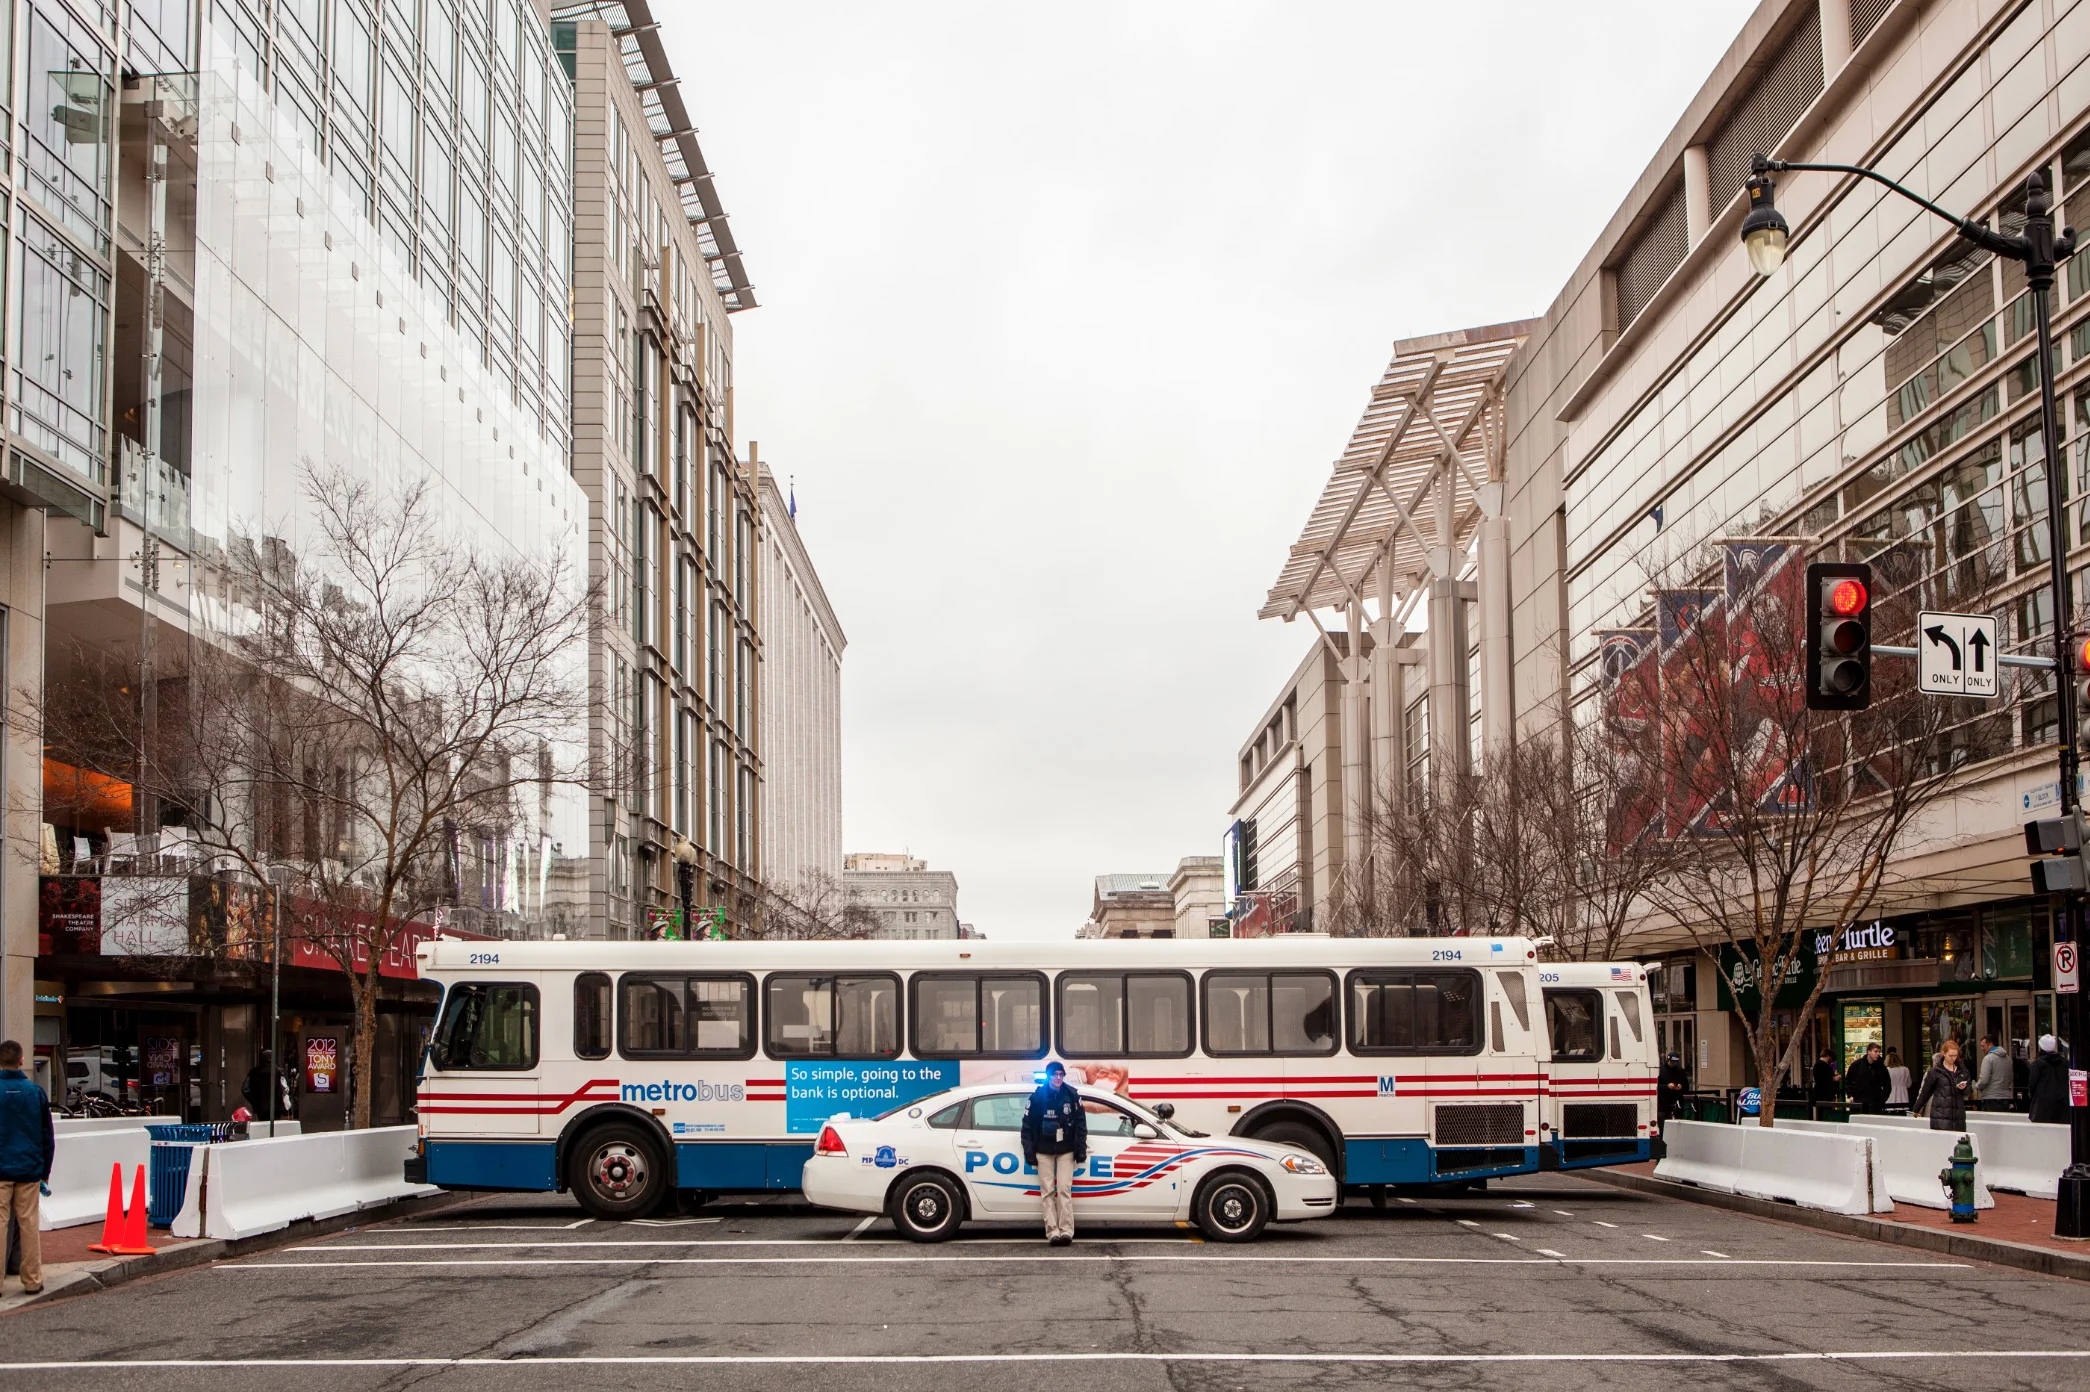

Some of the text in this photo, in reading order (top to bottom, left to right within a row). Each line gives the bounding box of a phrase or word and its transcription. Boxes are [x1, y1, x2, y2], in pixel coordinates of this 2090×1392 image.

[1932, 674, 1959, 684] ONLY
[1967, 677, 1992, 687] ONLY
[113, 930, 157, 943] HALL
[1841, 921, 1895, 950] Turtle
[470, 953, 499, 964] 2194
[1432, 950, 1462, 961] 2194
[1836, 953, 1849, 962] BAR
[1851, 952, 1856, 960] &
[1858, 949, 1888, 960] GRILLE
[307, 1038, 337, 1051] 2012
[307, 1054, 336, 1063] TONY
[307, 1062, 336, 1070] AWARD
[317, 1073, 327, 1084] S
[792, 1067, 942, 1084] So simple, going to the
[622, 1080, 744, 1101] metrobus
[1380, 1076, 1394, 1092] M
[791, 1085, 899, 1101] bank is optional.
[965, 1151, 1113, 1178] POLE
[1171, 1182, 1176, 1190] 1
